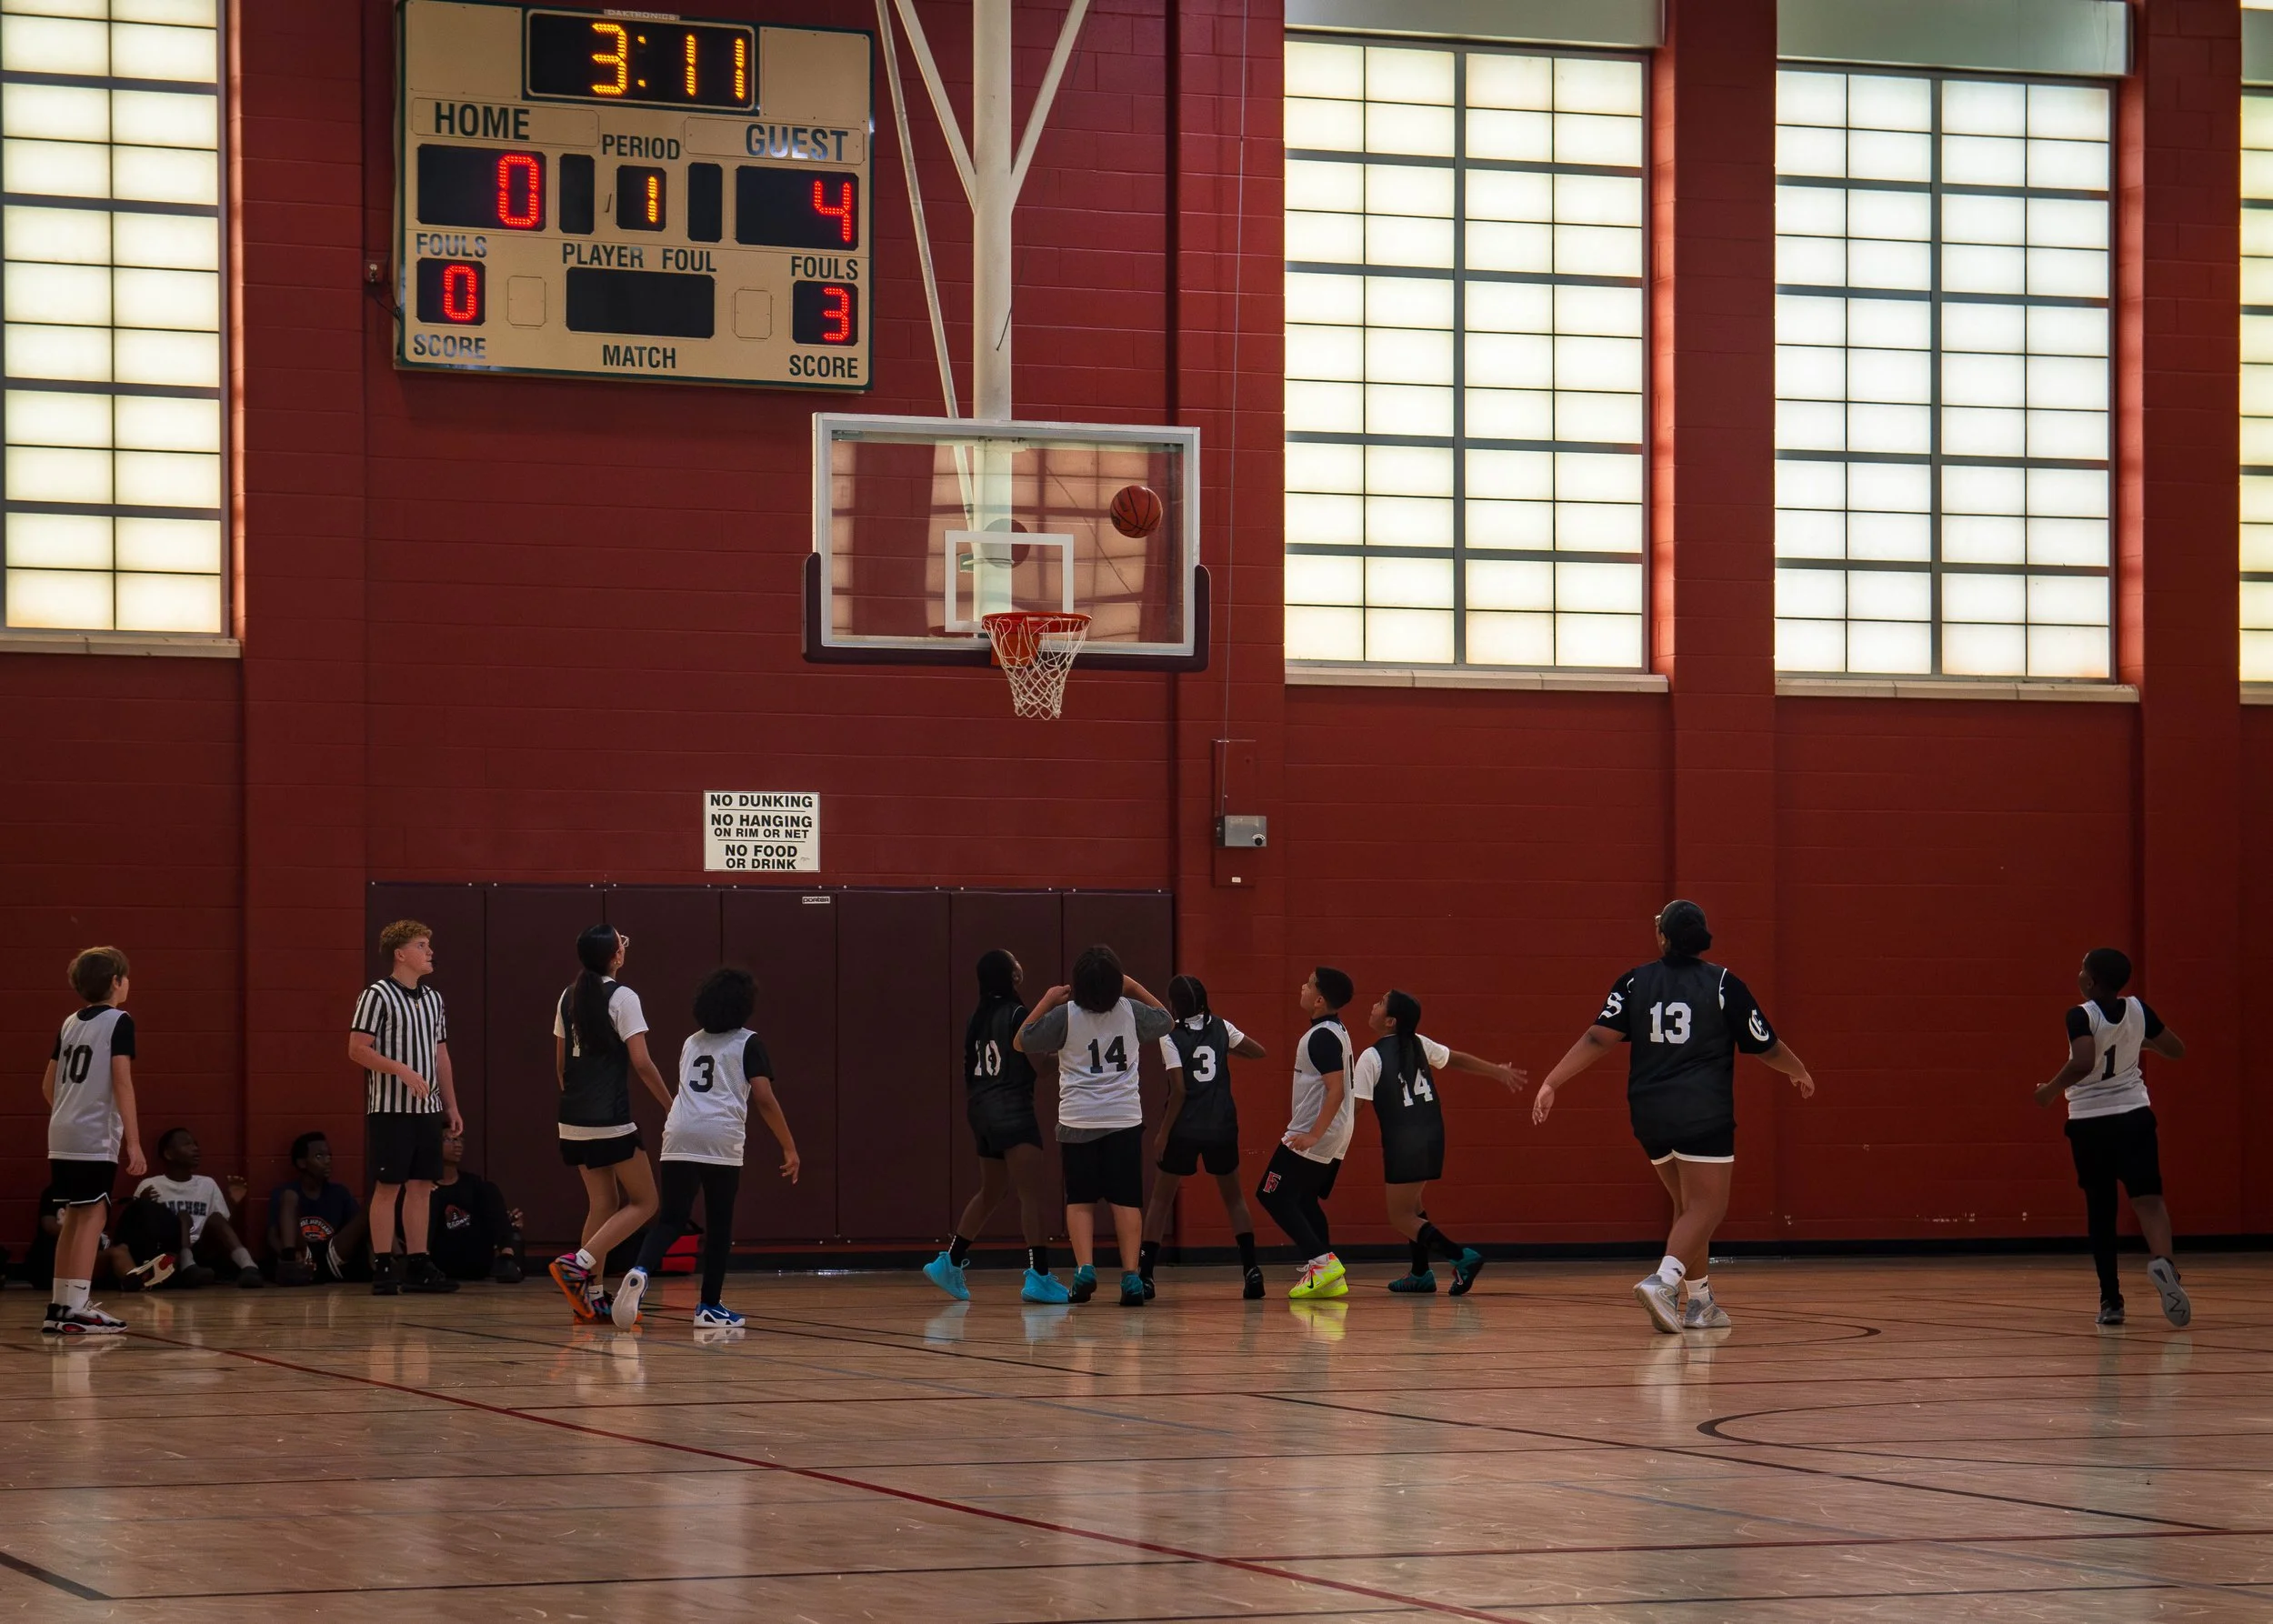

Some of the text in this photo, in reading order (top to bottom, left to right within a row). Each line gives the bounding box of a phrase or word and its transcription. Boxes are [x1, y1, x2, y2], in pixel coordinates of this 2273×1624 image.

[606, 9, 676, 21] DAKTRONICS
[592, 22, 745, 100] 3:11
[434, 102, 530, 141] HOME
[602, 135, 680, 160] PERIOD
[746, 124, 847, 161] GUEST
[497, 154, 539, 229] 0
[647, 176, 657, 223] 1
[813, 180, 852, 242] 4
[416, 233, 487, 258] FOULS
[562, 243, 716, 273] PLAYER FOUL
[791, 256, 858, 280] FOULS
[443, 265, 477, 321] 0
[823, 286, 849, 342] 3
[413, 335, 486, 359] SCORE
[602, 344, 676, 369] MATCH
[788, 355, 858, 379] SCORE
[710, 794, 813, 807] NO DUNKING
[711, 814, 813, 828] NO HANGING
[714, 827, 809, 839] ON RIM OR NET
[726, 844, 797, 857] NO FOOD
[726, 857, 796, 870] OR DRINK
[1650, 1001, 1692, 1045] 13
[62, 1044, 94, 1084] 10
[974, 1039, 1001, 1077] 10
[1087, 1035, 1127, 1074] 14
[1193, 1045, 1217, 1083] 3
[2101, 1044, 2117, 1081] 1
[689, 1055, 716, 1093] 3
[1397, 1068, 1434, 1108] 14
